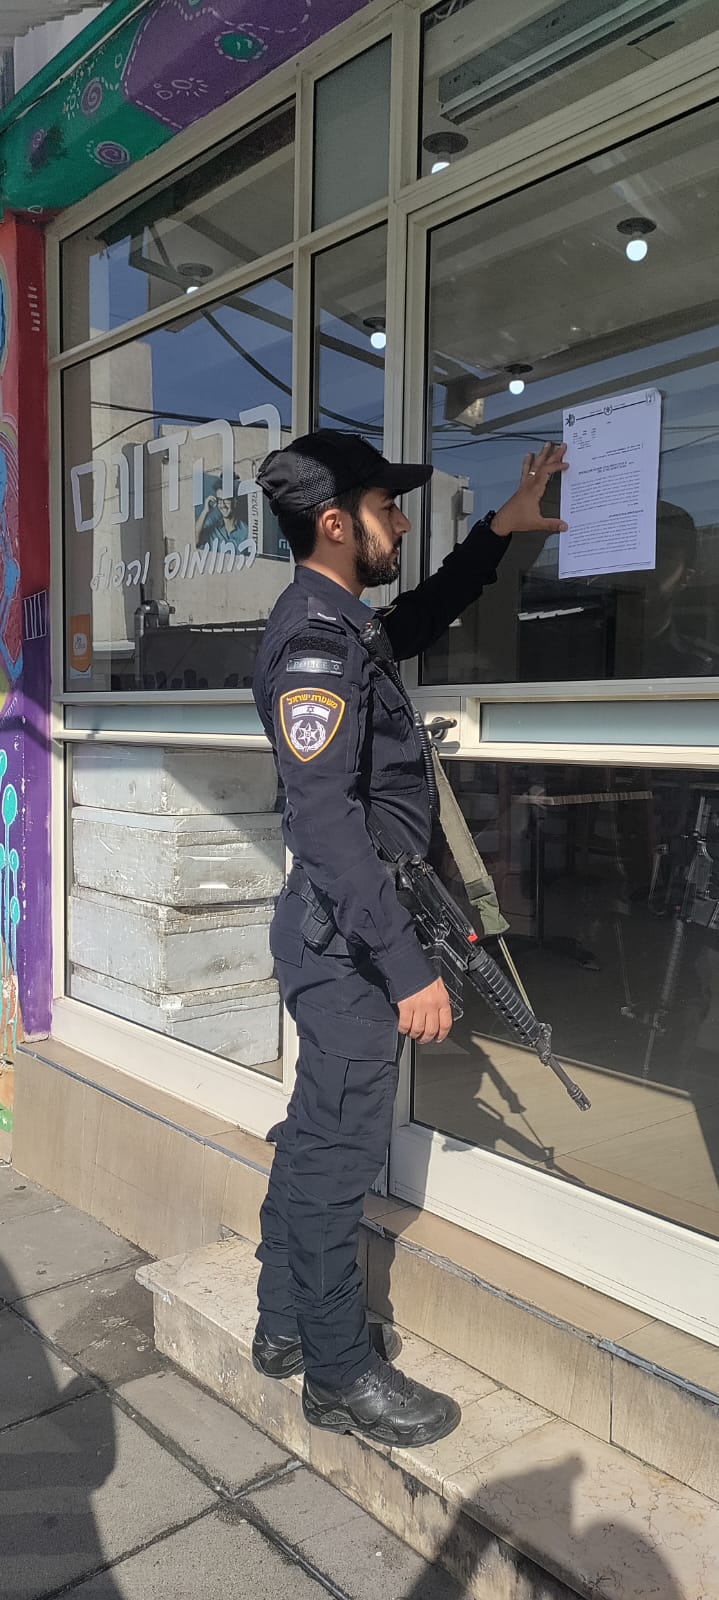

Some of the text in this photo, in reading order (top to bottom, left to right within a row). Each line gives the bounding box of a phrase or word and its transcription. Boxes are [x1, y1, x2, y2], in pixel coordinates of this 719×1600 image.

[90, 538, 257, 591] החומוס והפול
[286, 693, 338, 709] משטרת ישראל
